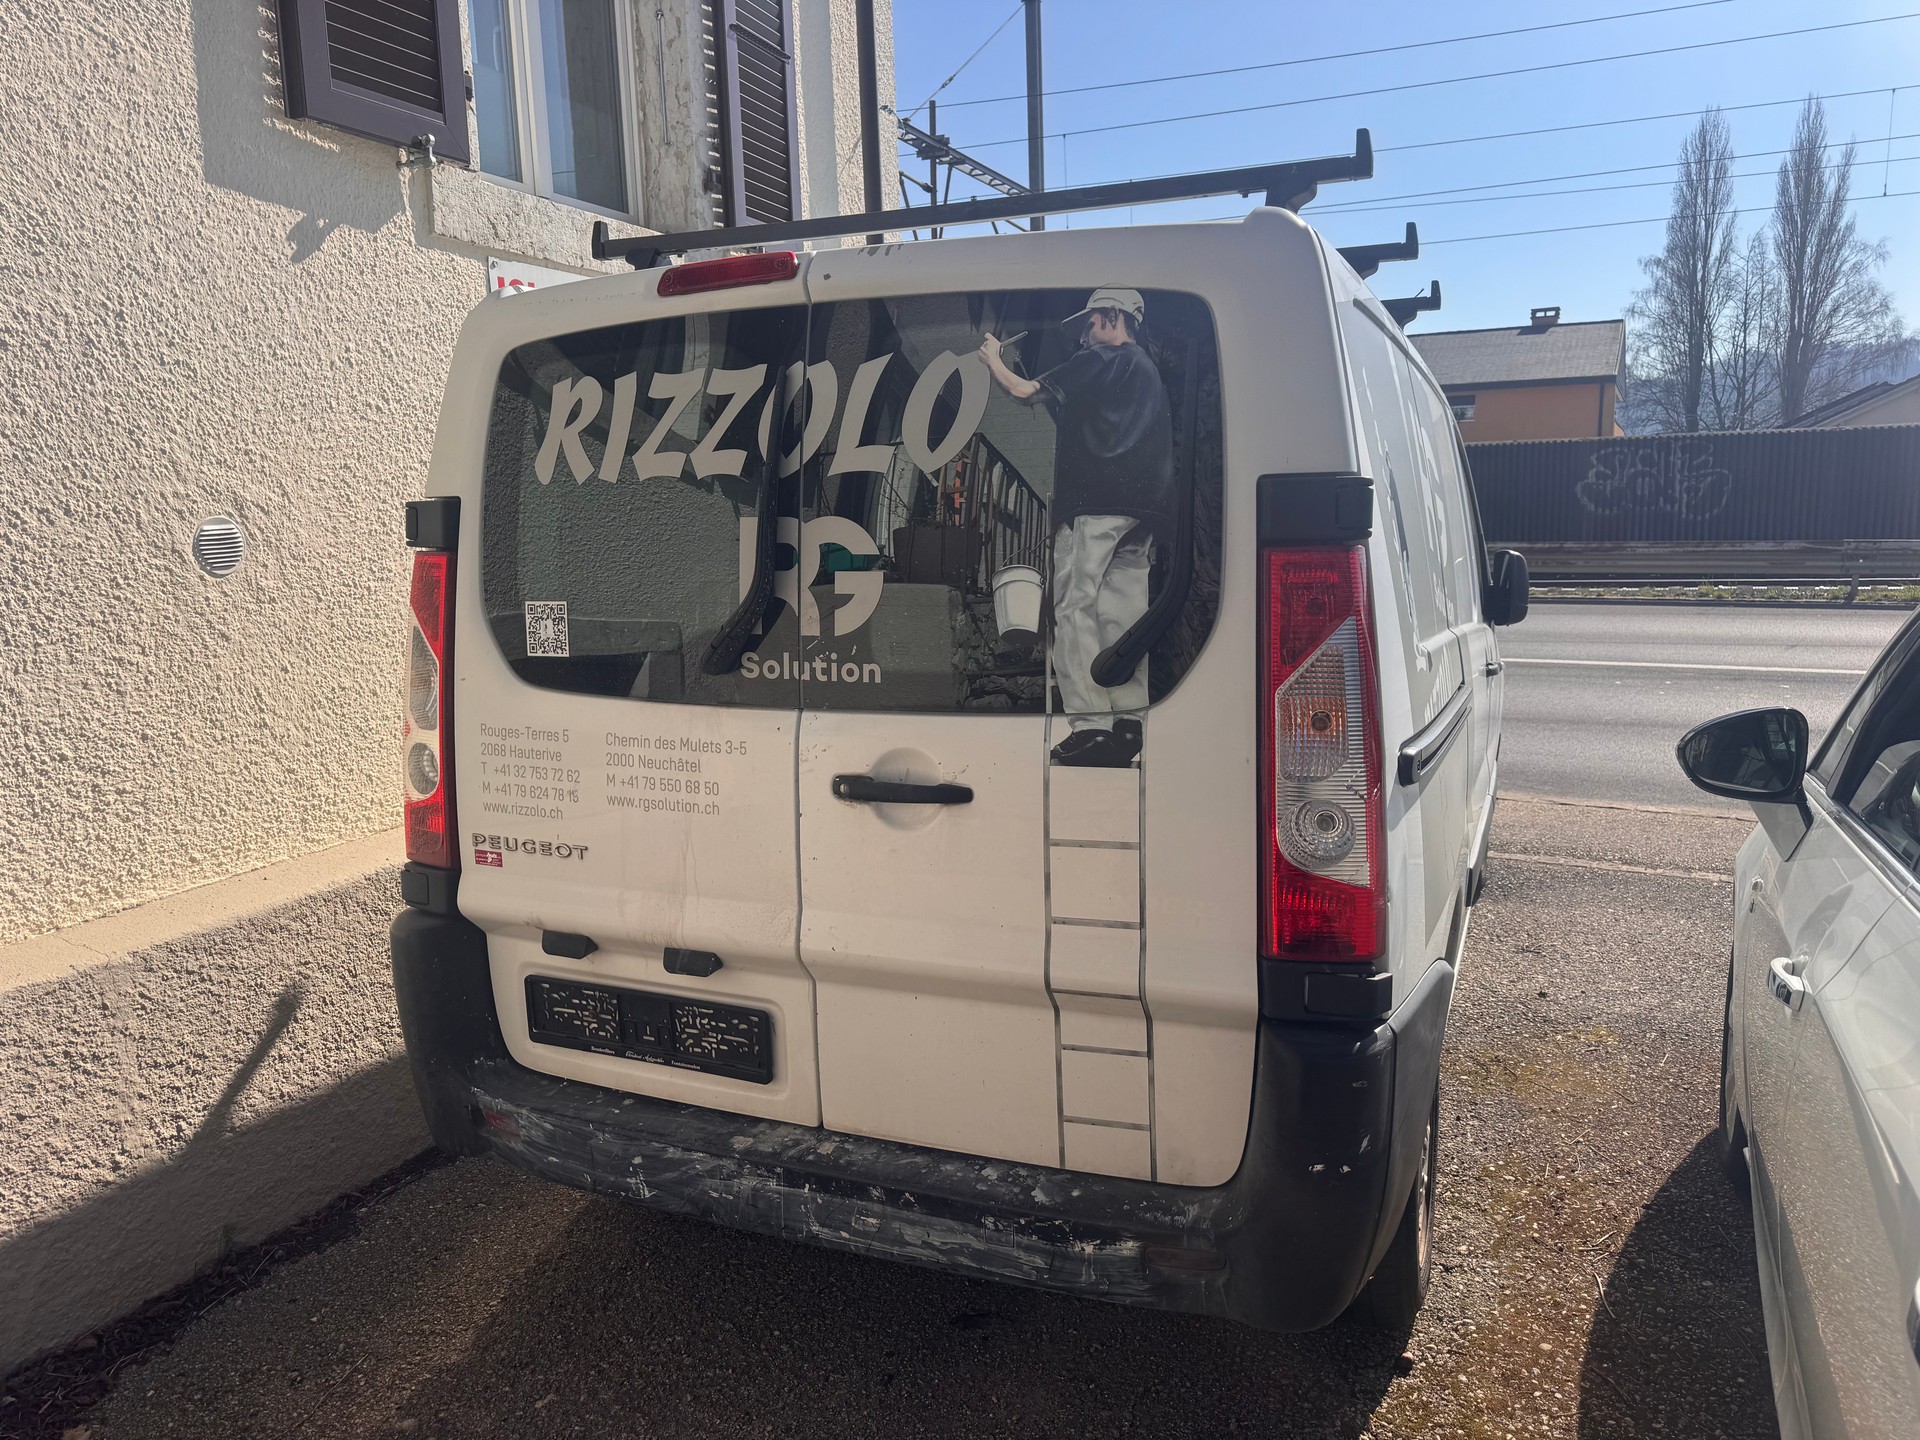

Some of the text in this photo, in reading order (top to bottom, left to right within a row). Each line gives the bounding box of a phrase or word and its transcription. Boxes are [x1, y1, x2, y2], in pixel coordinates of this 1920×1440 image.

[534, 349, 991, 487] RIZZOLO
[739, 515, 884, 637] RG
[740, 651, 882, 683] Solution
[480, 723, 569, 743] Rouges-Terres 5
[605, 732, 747, 756] Chemin des Mulets 3-5
[480, 742, 562, 762] 2068 Hauterive
[605, 752, 702, 773] 2000 Neuchâtel
[481, 761, 581, 784] T +41 32 753 72 62
[482, 781, 491, 794] M
[494, 782, 511, 796] +41
[514, 783, 527, 798] 79
[529, 785, 549, 800] 624
[551, 787, 565, 802] 78
[606, 773, 720, 796] M +41 79 550 68 50
[482, 801, 563, 820] www.rizzolo.ch
[606, 795, 720, 816] www.rgsolution.ch
[472, 832, 588, 860] PEUGEOT
